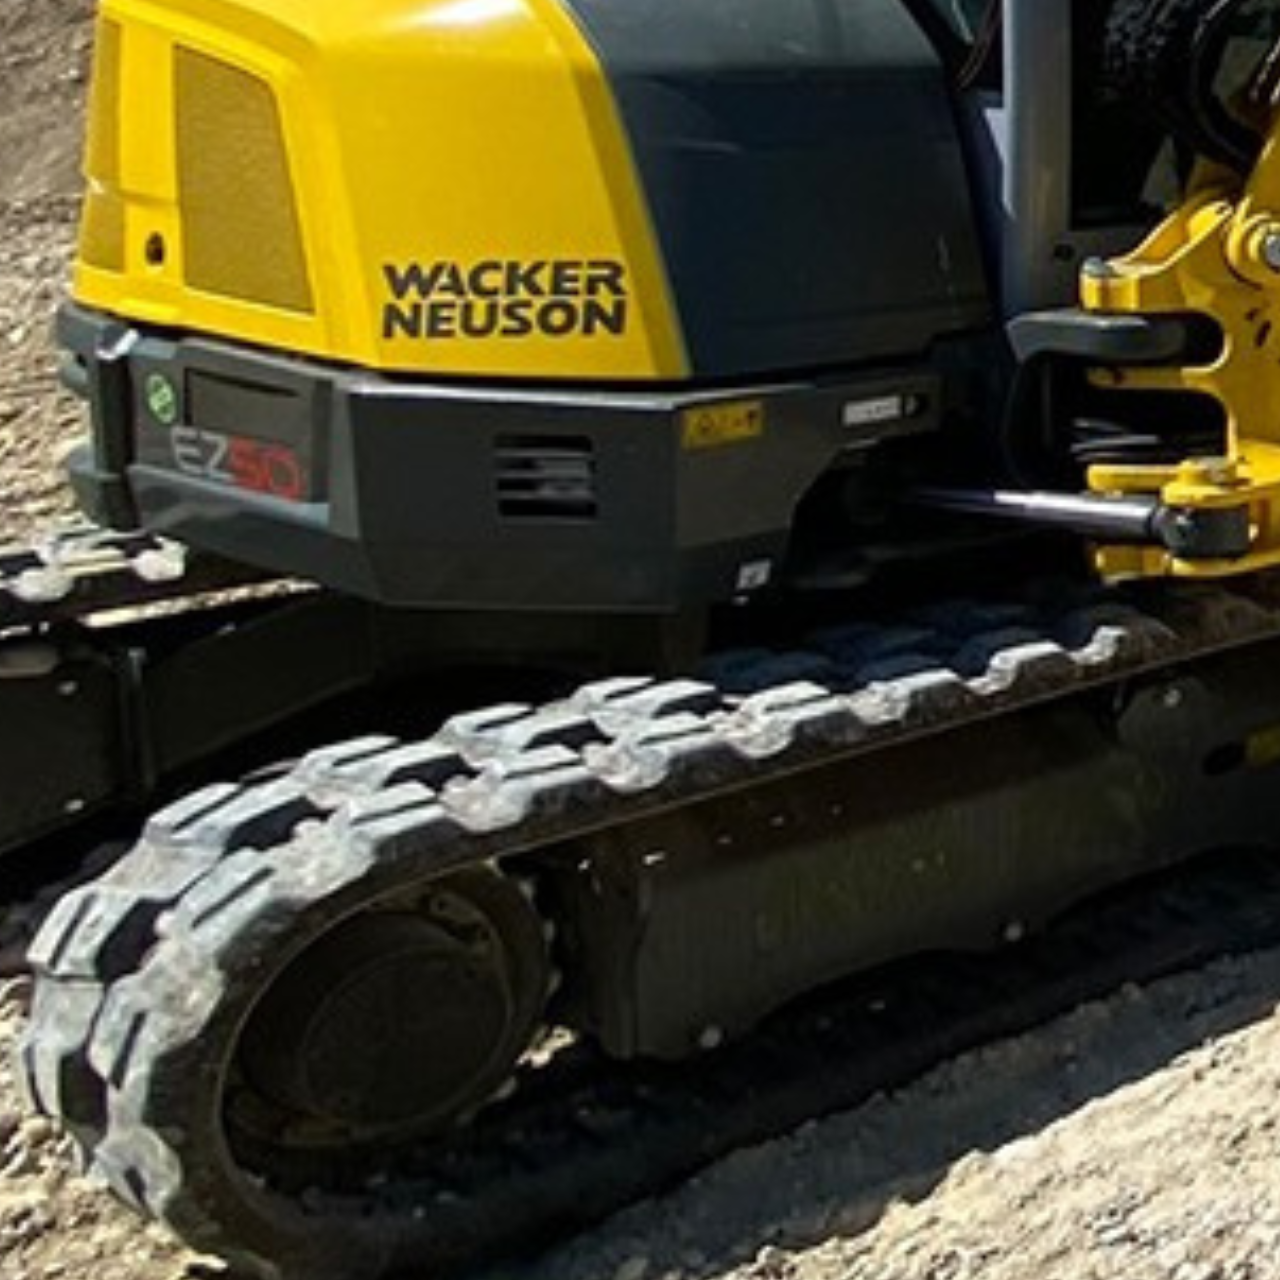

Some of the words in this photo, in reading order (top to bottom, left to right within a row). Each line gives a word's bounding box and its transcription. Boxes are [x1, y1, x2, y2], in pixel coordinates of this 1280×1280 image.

[382, 260, 626, 299] WACKER
[382, 299, 626, 338] NEUSON
[171, 425, 307, 501] EZ50
